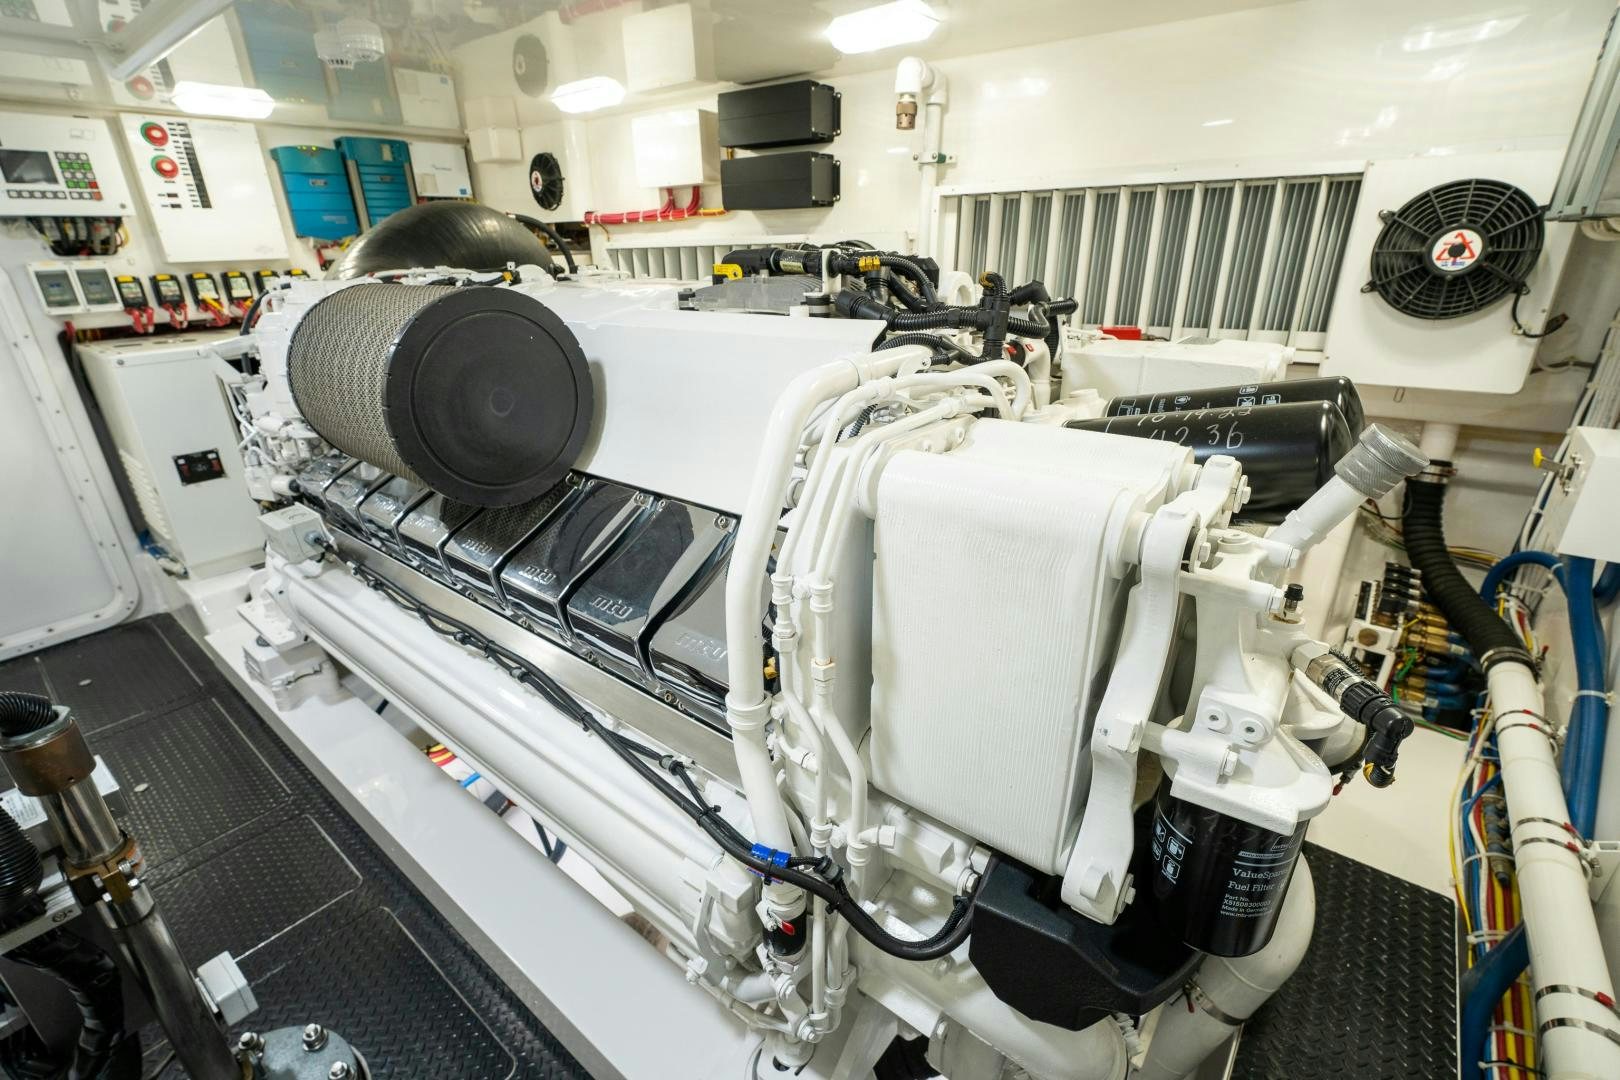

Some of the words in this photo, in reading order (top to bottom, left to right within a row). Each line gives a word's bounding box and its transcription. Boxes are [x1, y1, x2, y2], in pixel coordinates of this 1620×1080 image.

[518, 565, 557, 585] mtu
[588, 595, 634, 619] mtu
[1227, 880, 1250, 891] Fuel
[1225, 893, 1239, 901] Part
